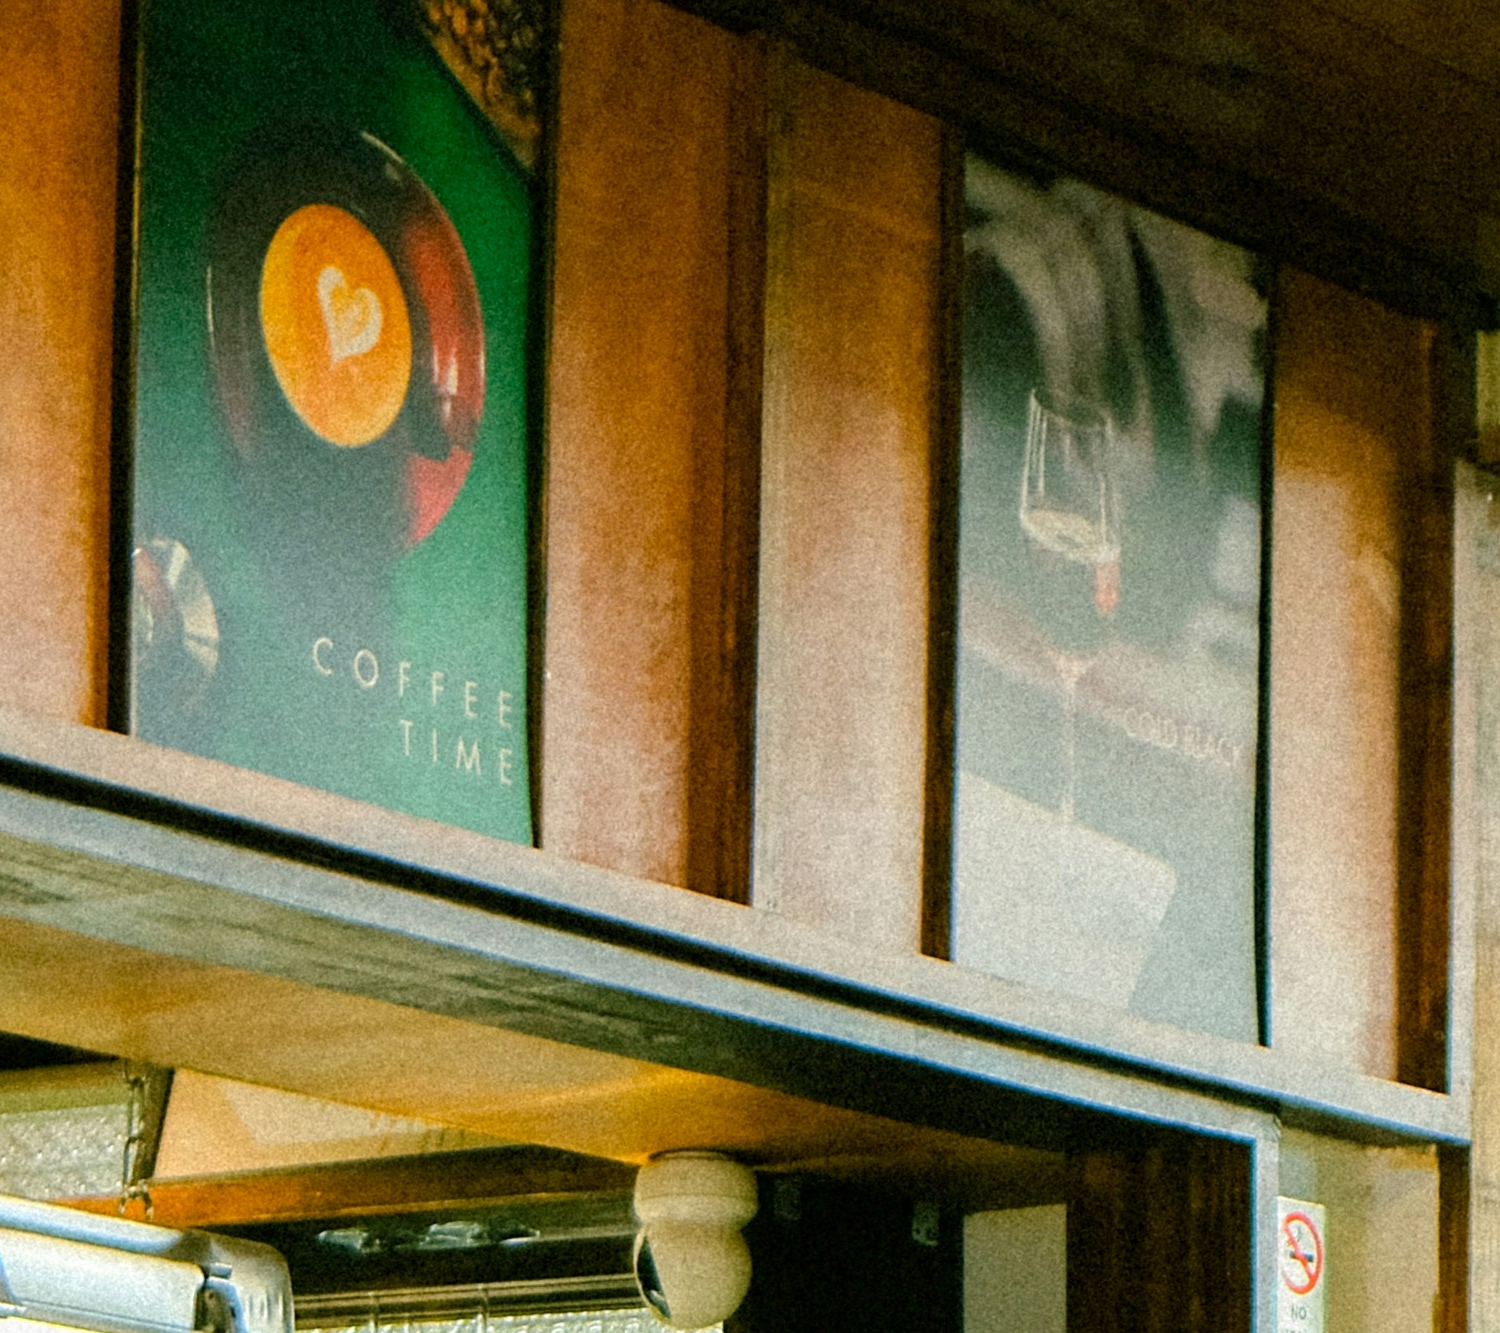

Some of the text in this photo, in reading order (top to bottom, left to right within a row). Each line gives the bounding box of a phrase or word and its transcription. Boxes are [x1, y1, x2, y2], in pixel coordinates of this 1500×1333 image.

[312, 636, 513, 729] COFFEE
[400, 720, 513, 785] TIME
[1124, 707, 1245, 768] COLD BLACK
[1291, 1305, 1307, 1320] NO
